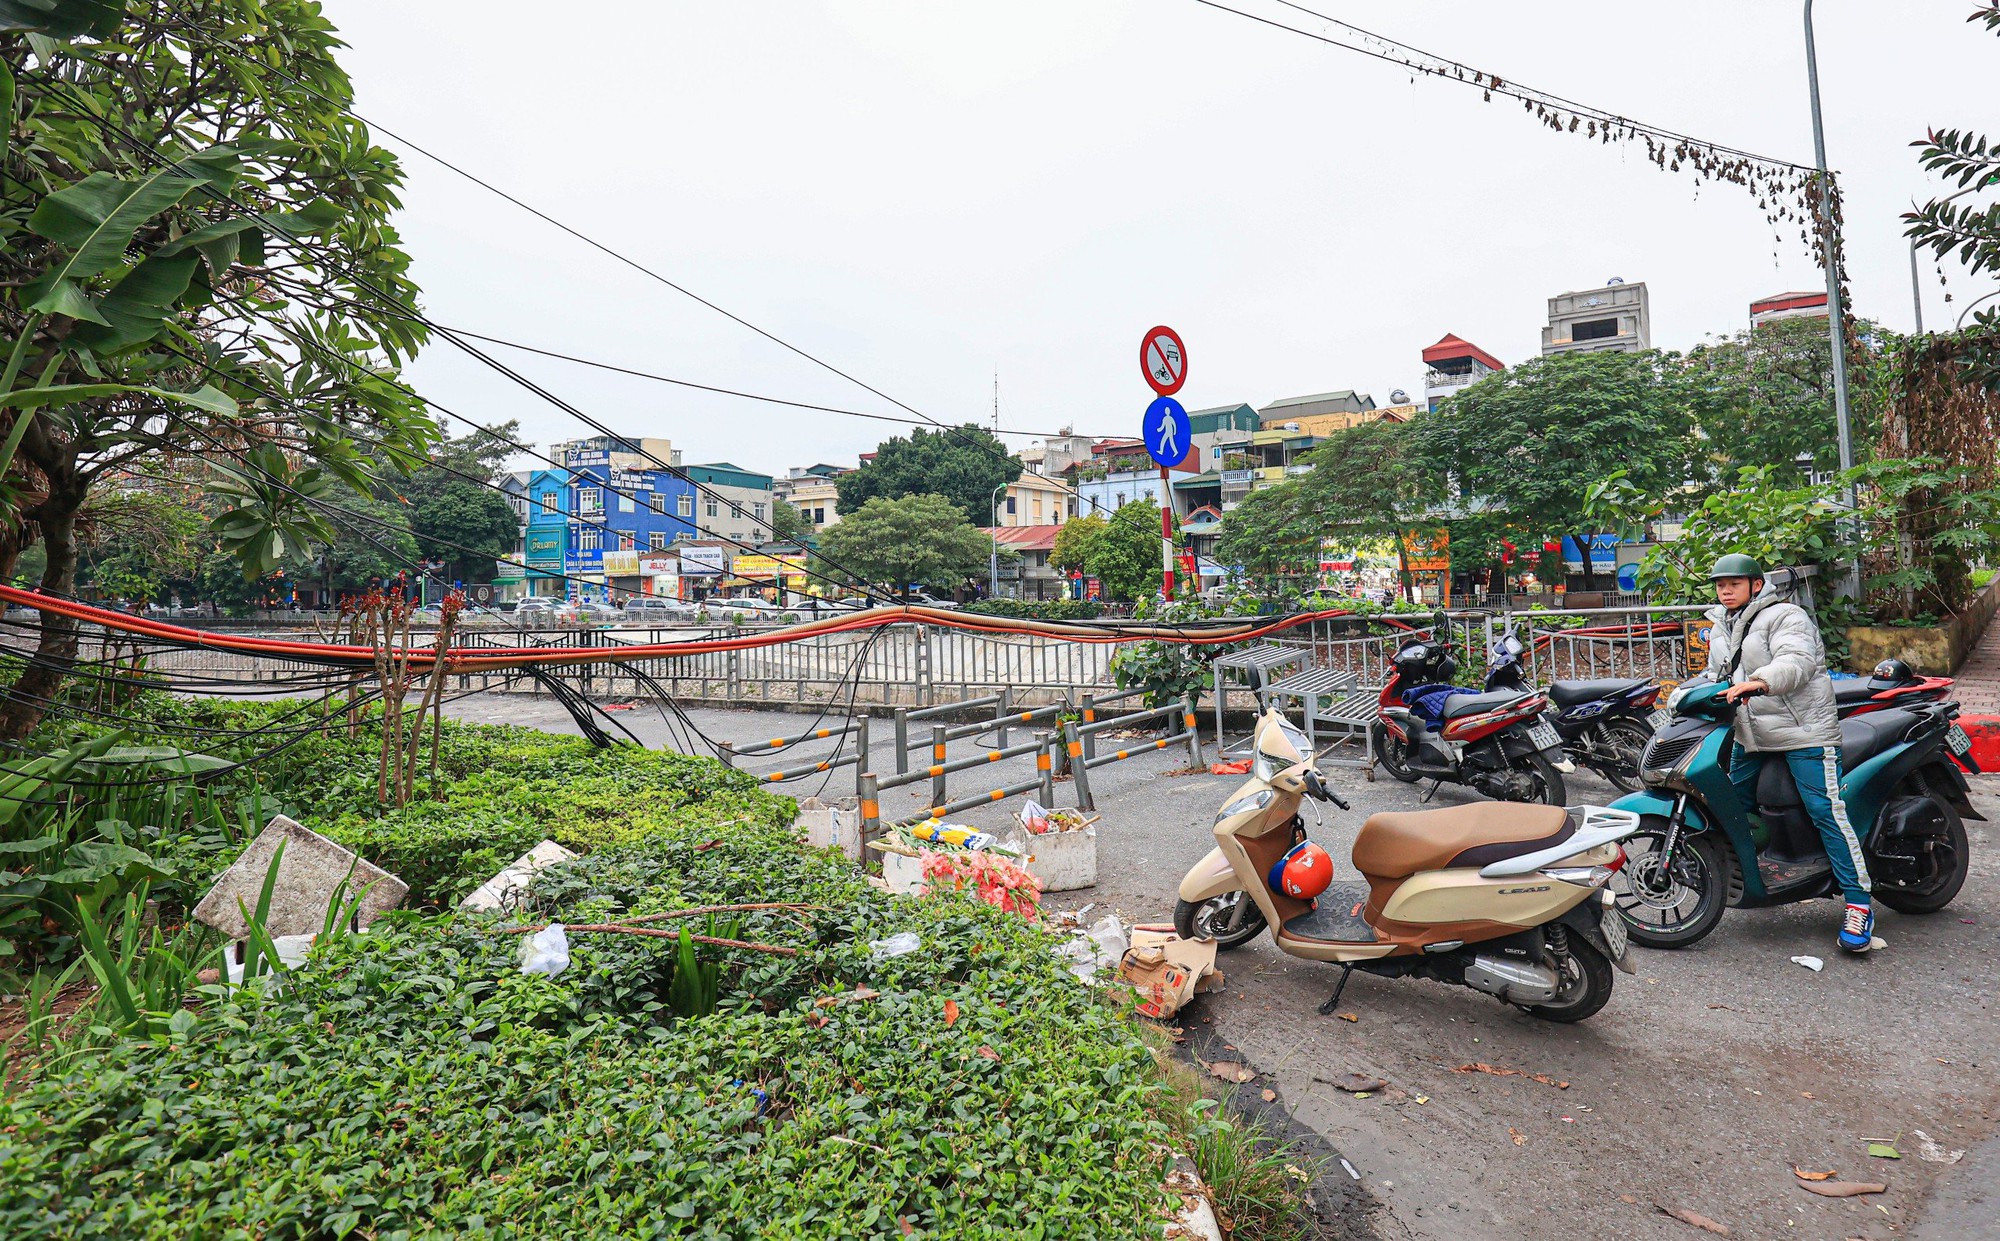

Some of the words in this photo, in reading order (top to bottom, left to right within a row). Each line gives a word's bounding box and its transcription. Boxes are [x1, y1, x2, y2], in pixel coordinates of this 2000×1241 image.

[1531, 724, 1552, 739] 29-E1
[1535, 733, 1560, 749] 711.67
[1497, 885, 1551, 895] LEAD
